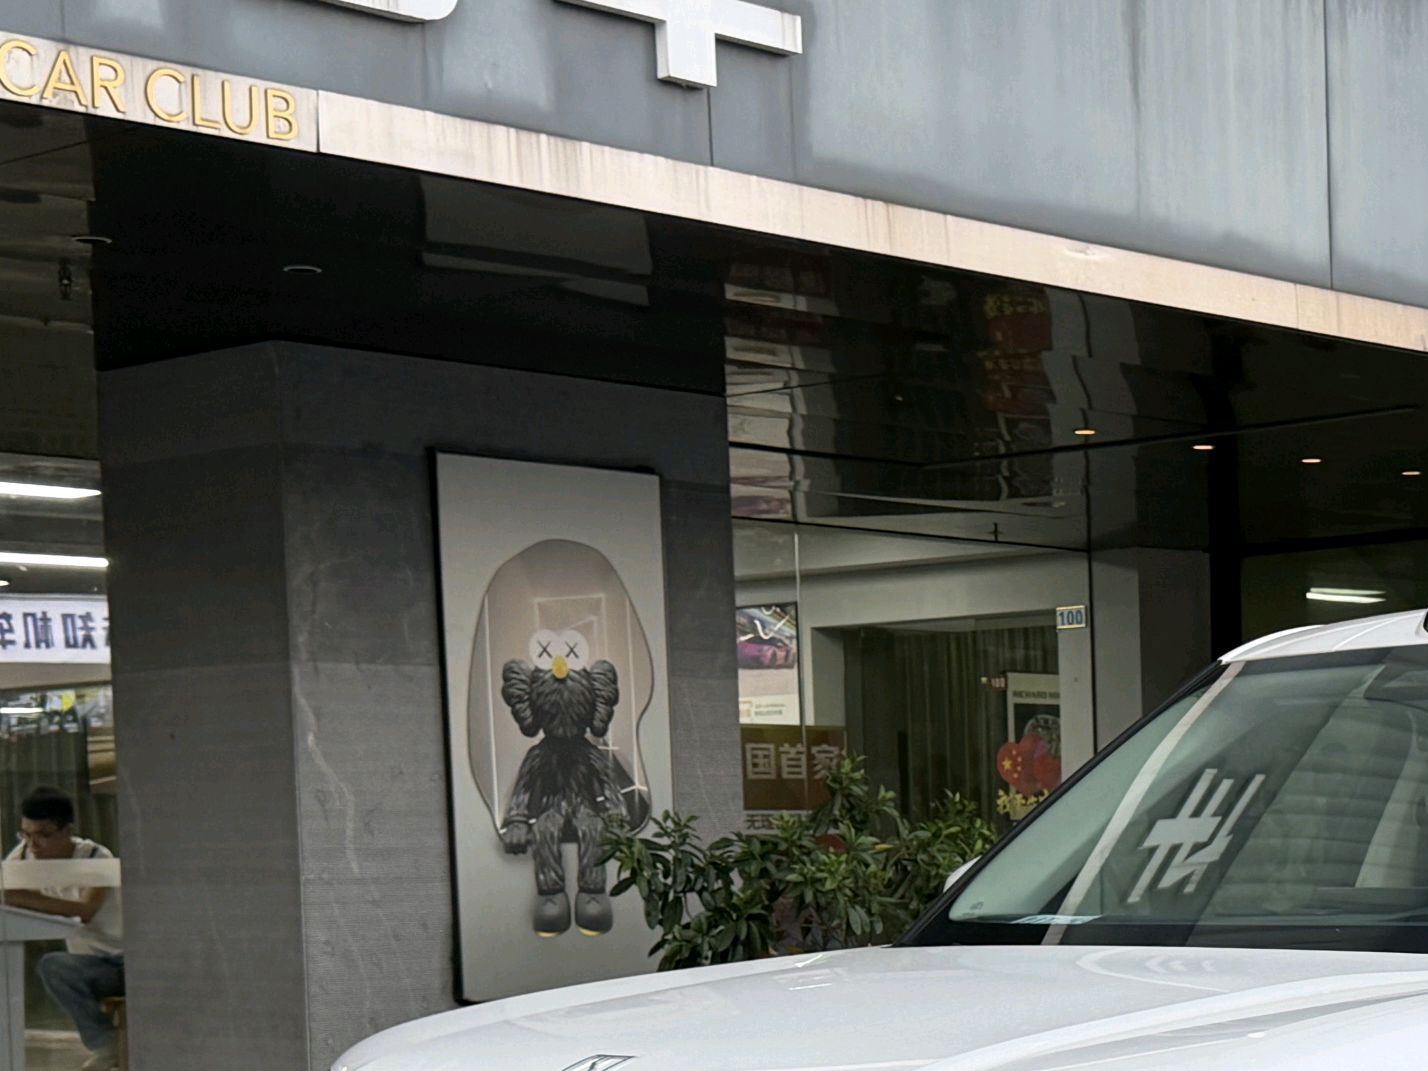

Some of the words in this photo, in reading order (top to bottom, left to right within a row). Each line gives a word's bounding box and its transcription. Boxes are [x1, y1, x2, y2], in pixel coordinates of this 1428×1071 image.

[0, 39, 126, 113] CAR
[145, 67, 300, 141] CLUB
[1058, 610, 1084, 626] 100
